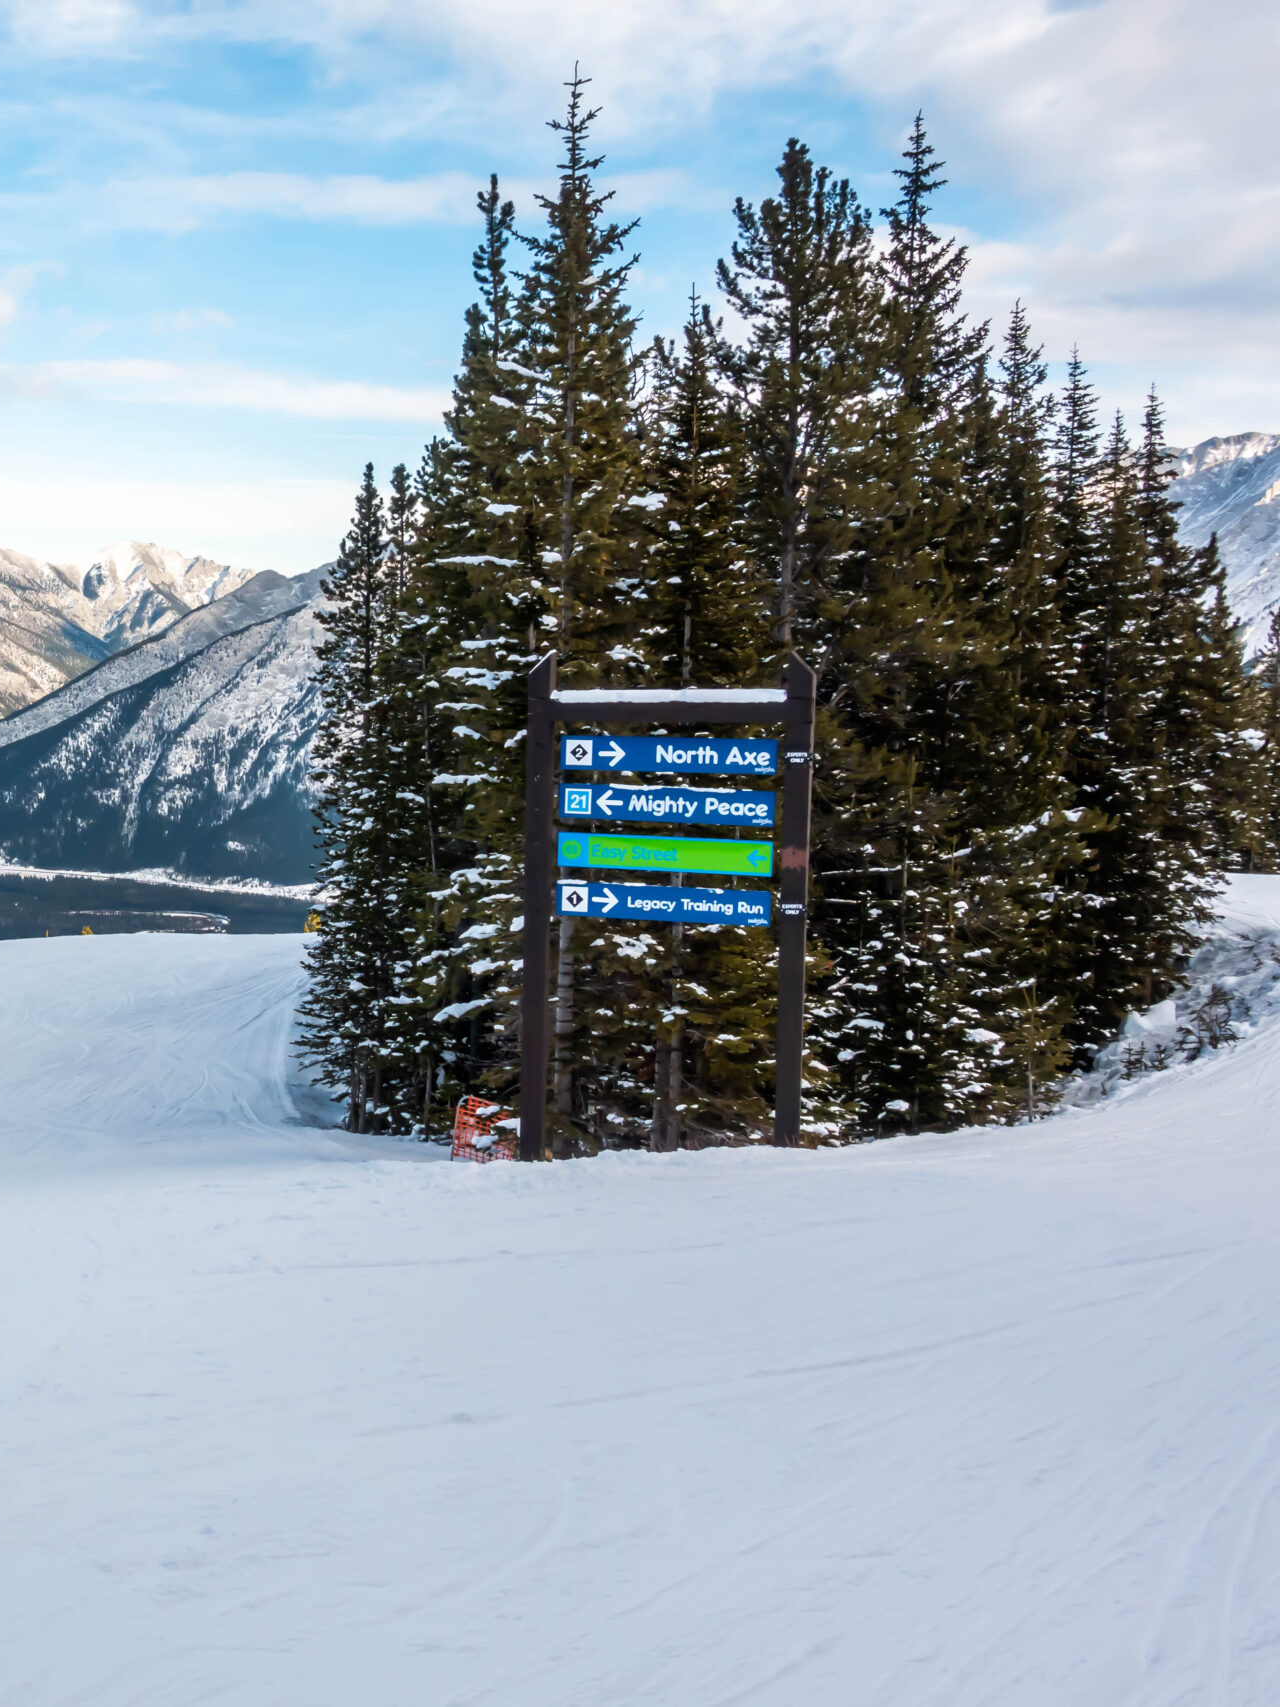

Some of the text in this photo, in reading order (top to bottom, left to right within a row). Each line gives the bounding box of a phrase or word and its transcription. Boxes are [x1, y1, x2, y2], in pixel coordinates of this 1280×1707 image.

[574, 748, 583, 758] 2
[655, 744, 771, 766] North Axe
[570, 794, 587, 809] 21
[628, 794, 768, 818] Mighty Peace
[592, 844, 679, 862] Easy Street
[571, 894, 578, 905] 1
[627, 896, 764, 915] Legacy Training Run
